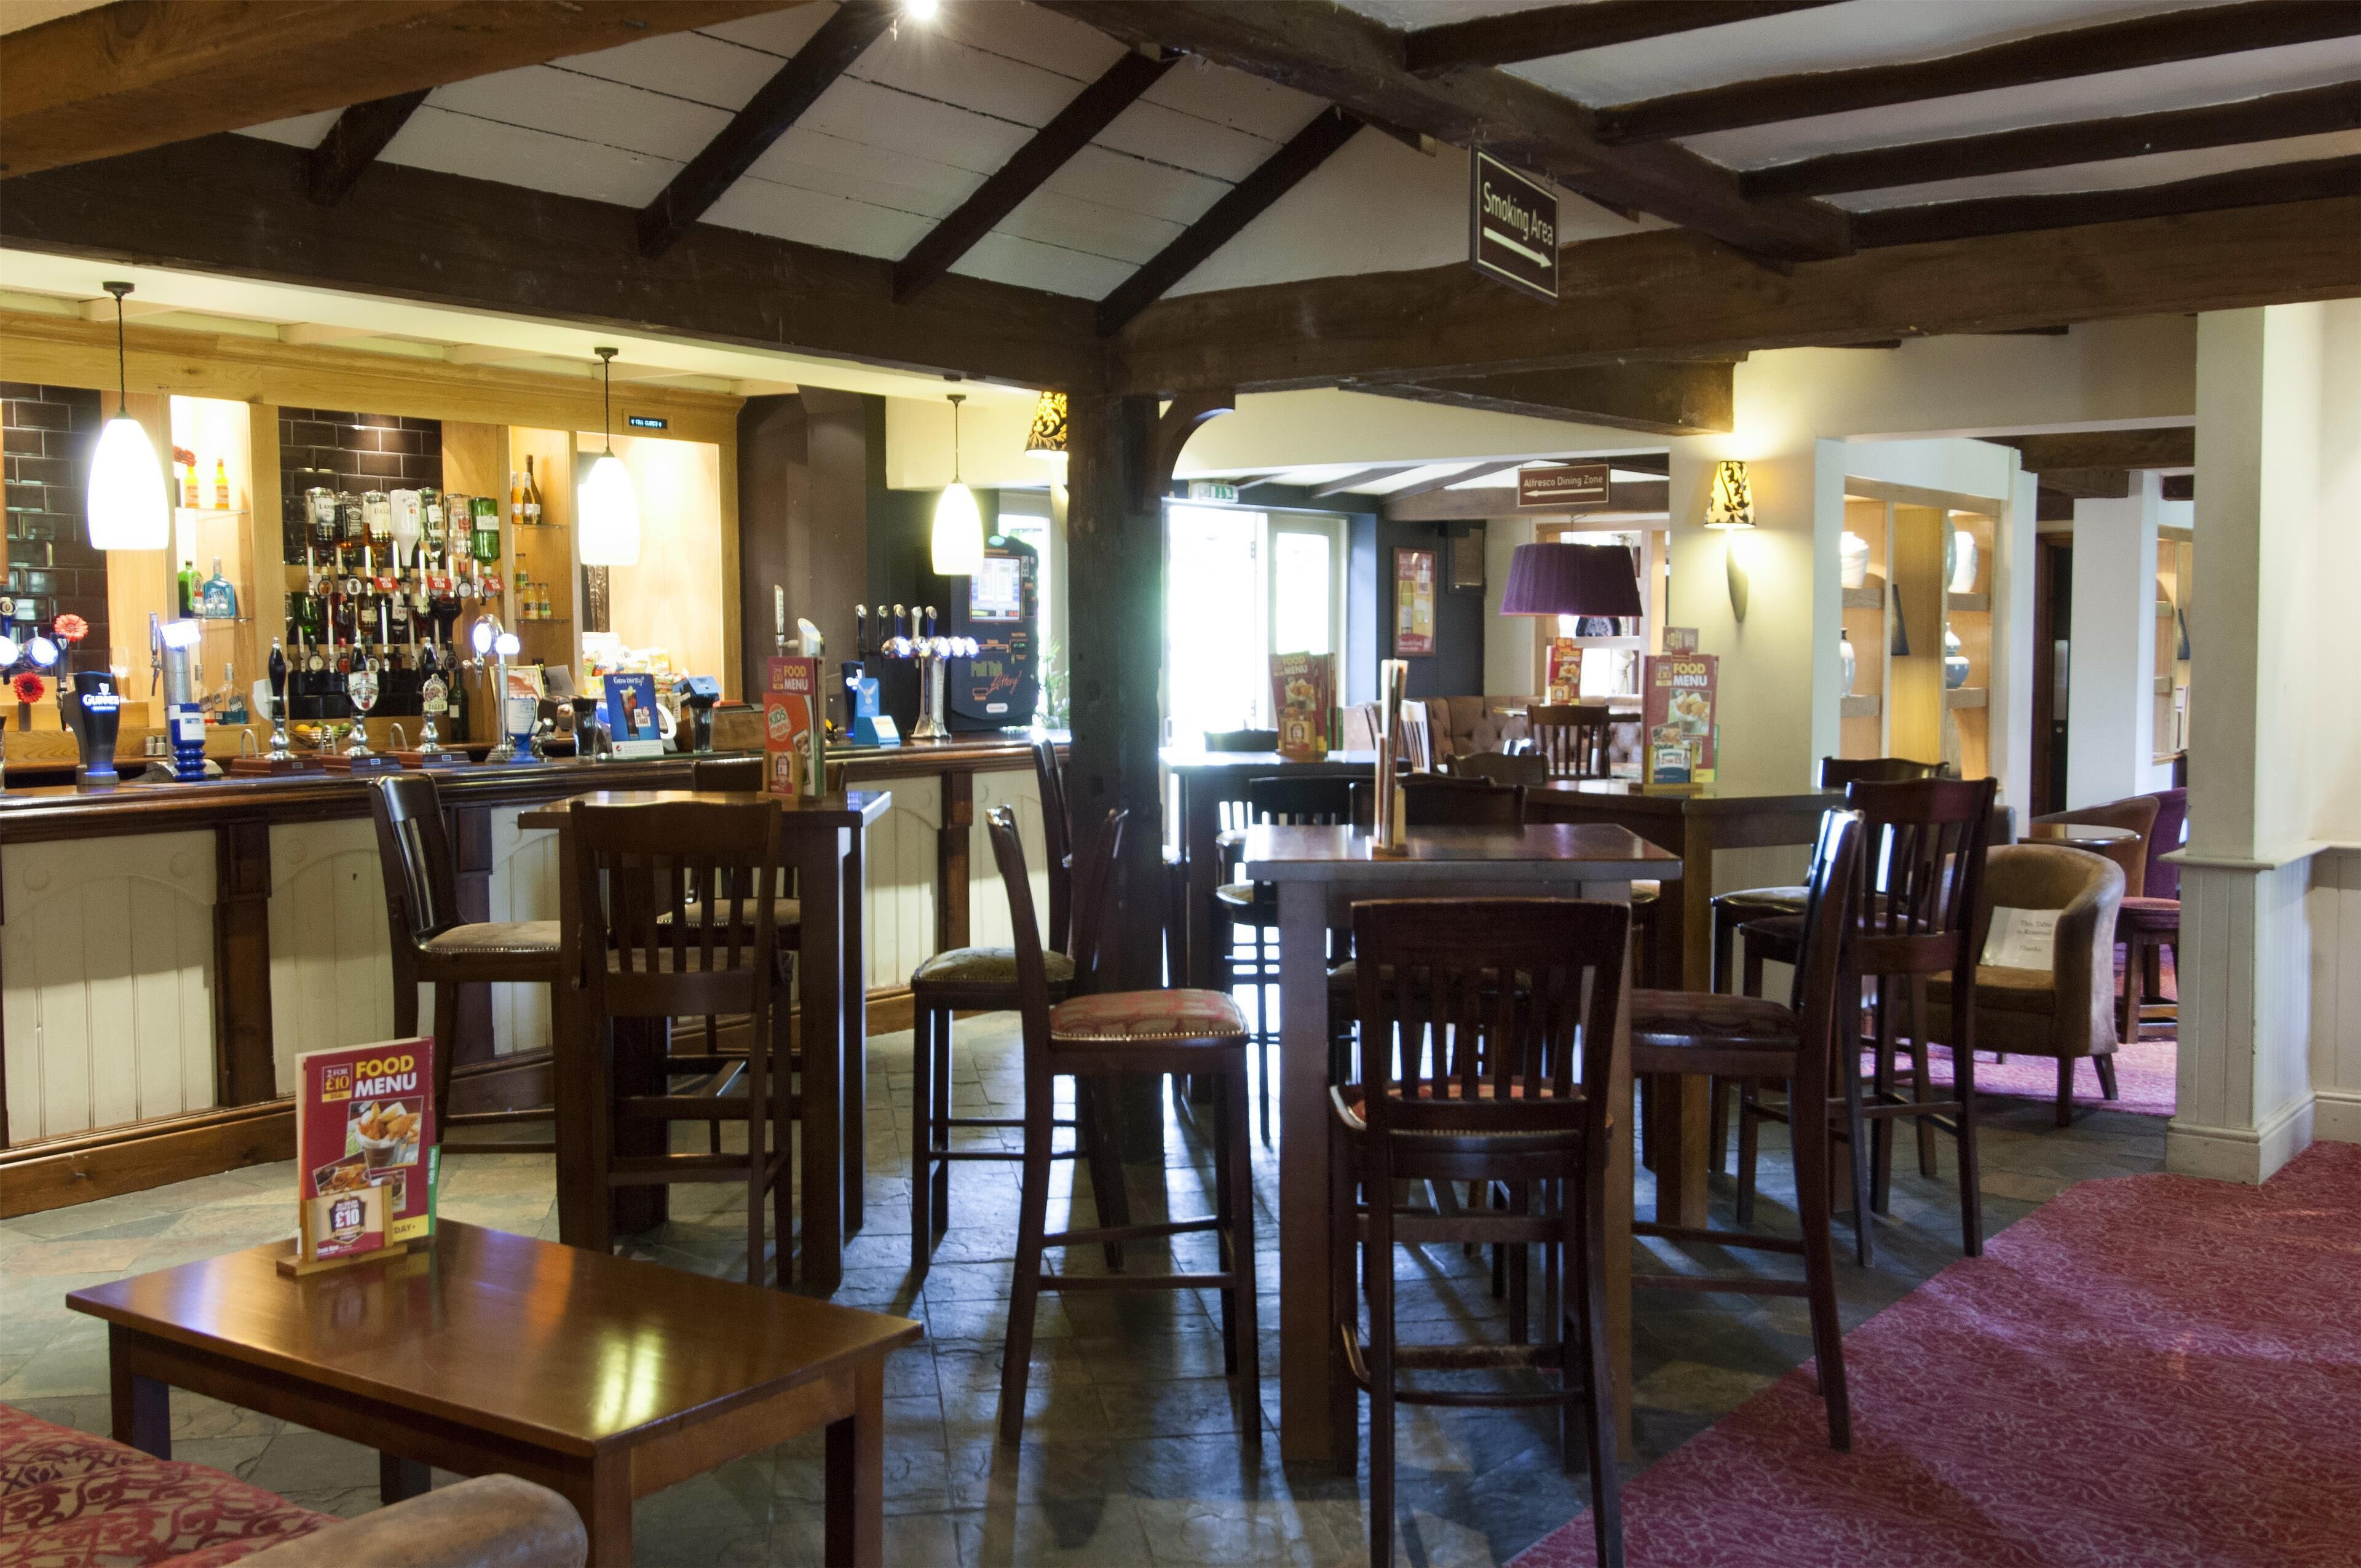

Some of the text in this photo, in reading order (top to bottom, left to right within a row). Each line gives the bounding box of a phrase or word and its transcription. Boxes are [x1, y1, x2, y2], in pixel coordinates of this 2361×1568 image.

[1483, 181, 1553, 246] Smoking Area
[1523, 475, 1604, 488] Alfresco Dining Zone
[783, 665, 807, 677] FOOD
[1673, 663, 1706, 674] FOOD
[784, 678, 809, 691] MENU
[1673, 675, 1707, 686] MENU
[769, 708, 786, 725] KIDS
[326, 1069, 333, 1078] 2
[355, 1055, 414, 1079] FOOD
[325, 1075, 350, 1091] £10
[354, 1072, 417, 1098] MENU
[335, 1208, 360, 1228] £10
